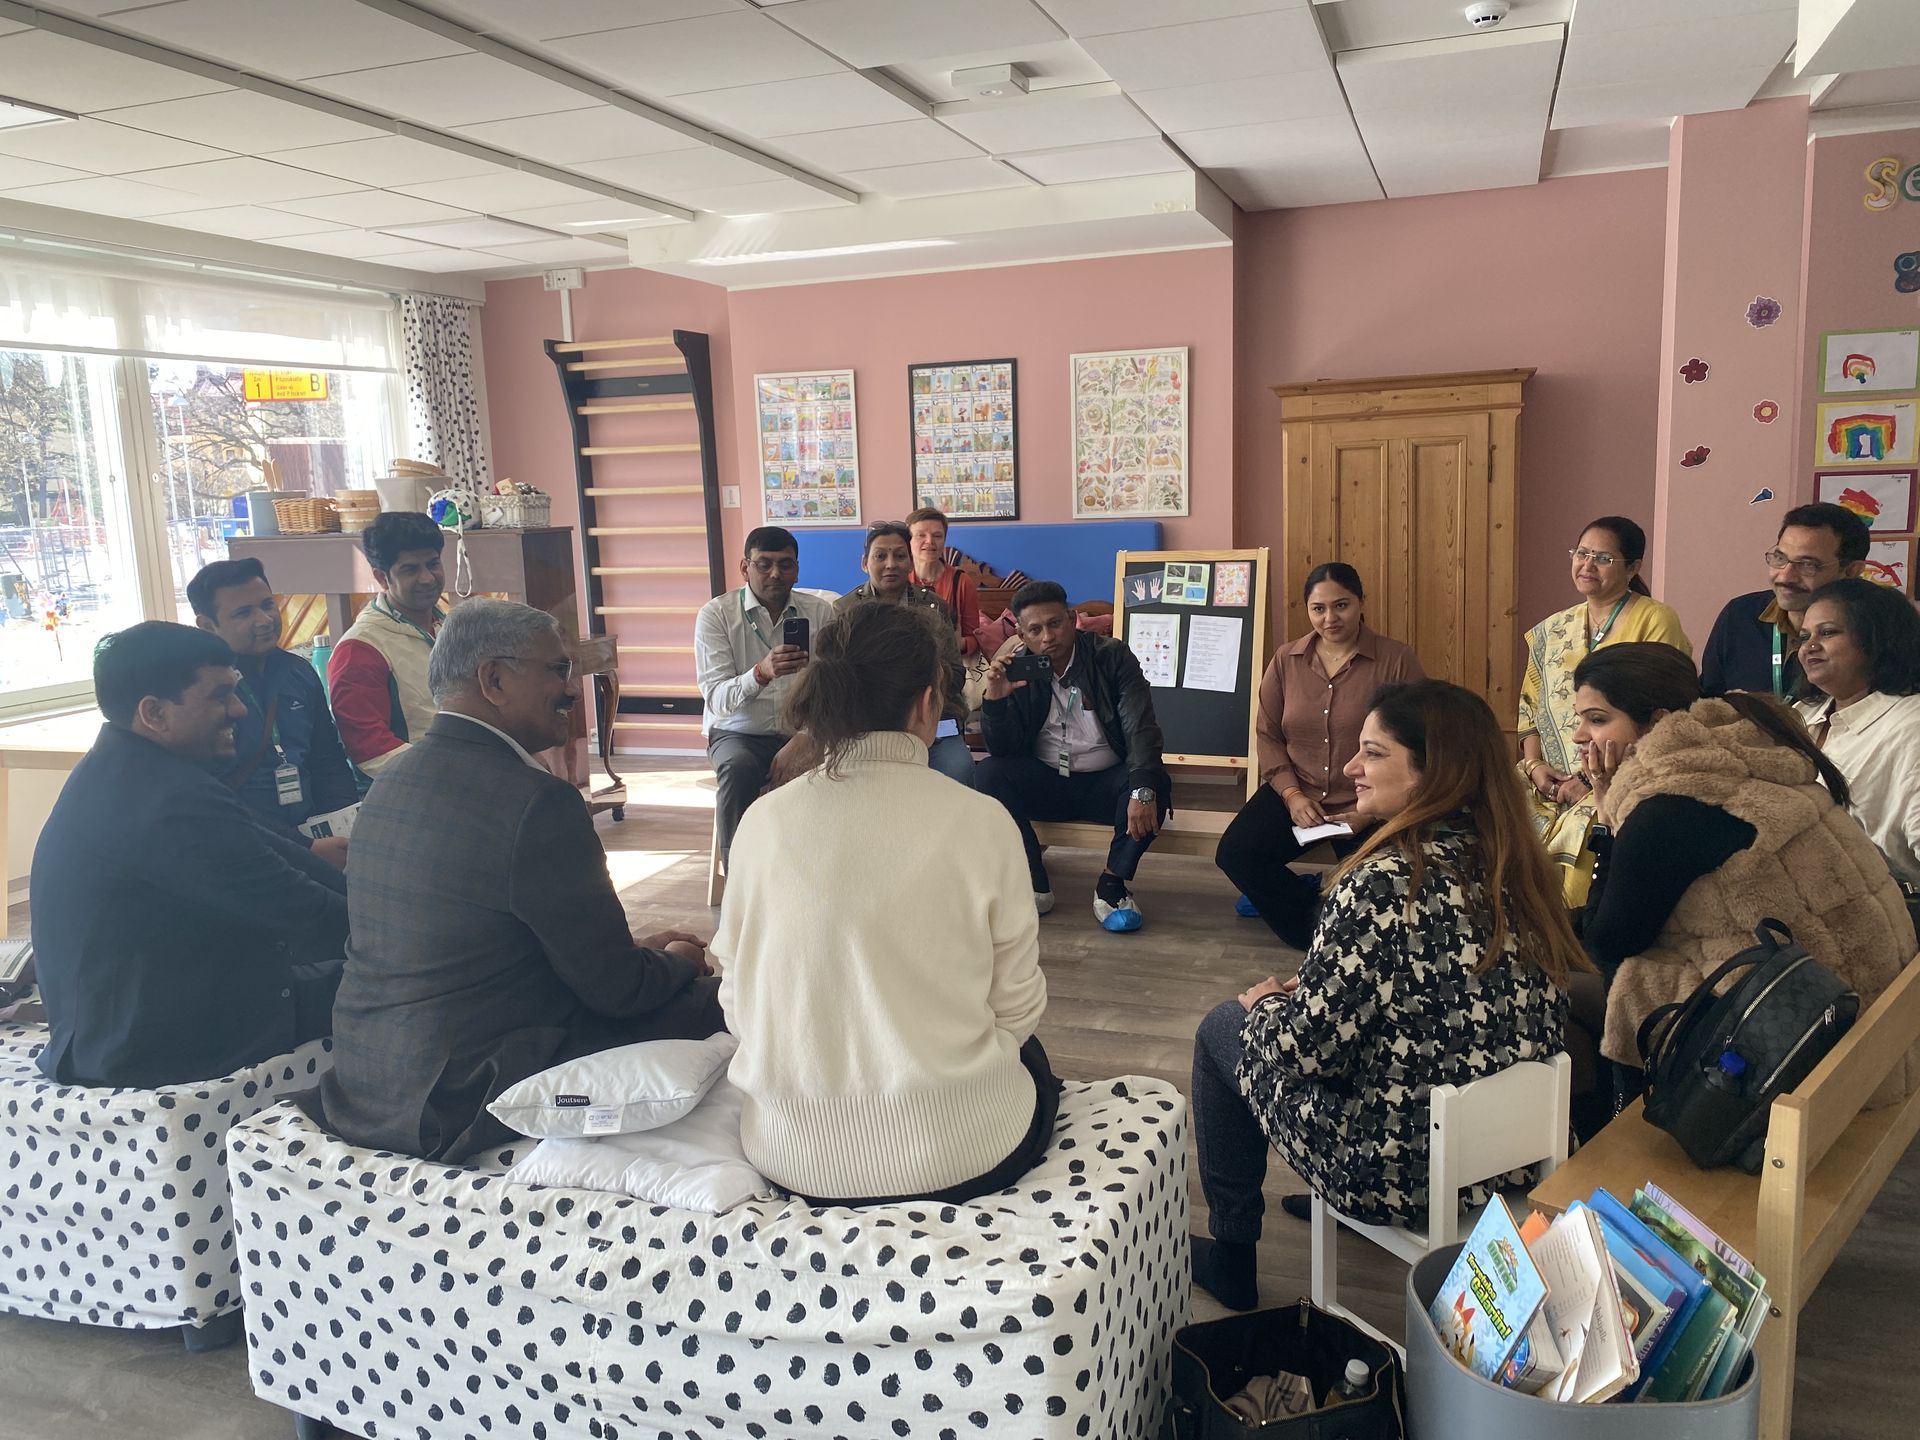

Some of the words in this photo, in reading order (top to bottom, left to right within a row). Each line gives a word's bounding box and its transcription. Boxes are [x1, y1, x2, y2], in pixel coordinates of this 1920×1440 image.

[256, 383, 260, 398] 1
[310, 373, 320, 392] B
[557, 1096, 587, 1105] Joutsen
[1467, 1252, 1497, 1301] Tervetuloa
[1470, 1276, 1513, 1340] Galariin!
